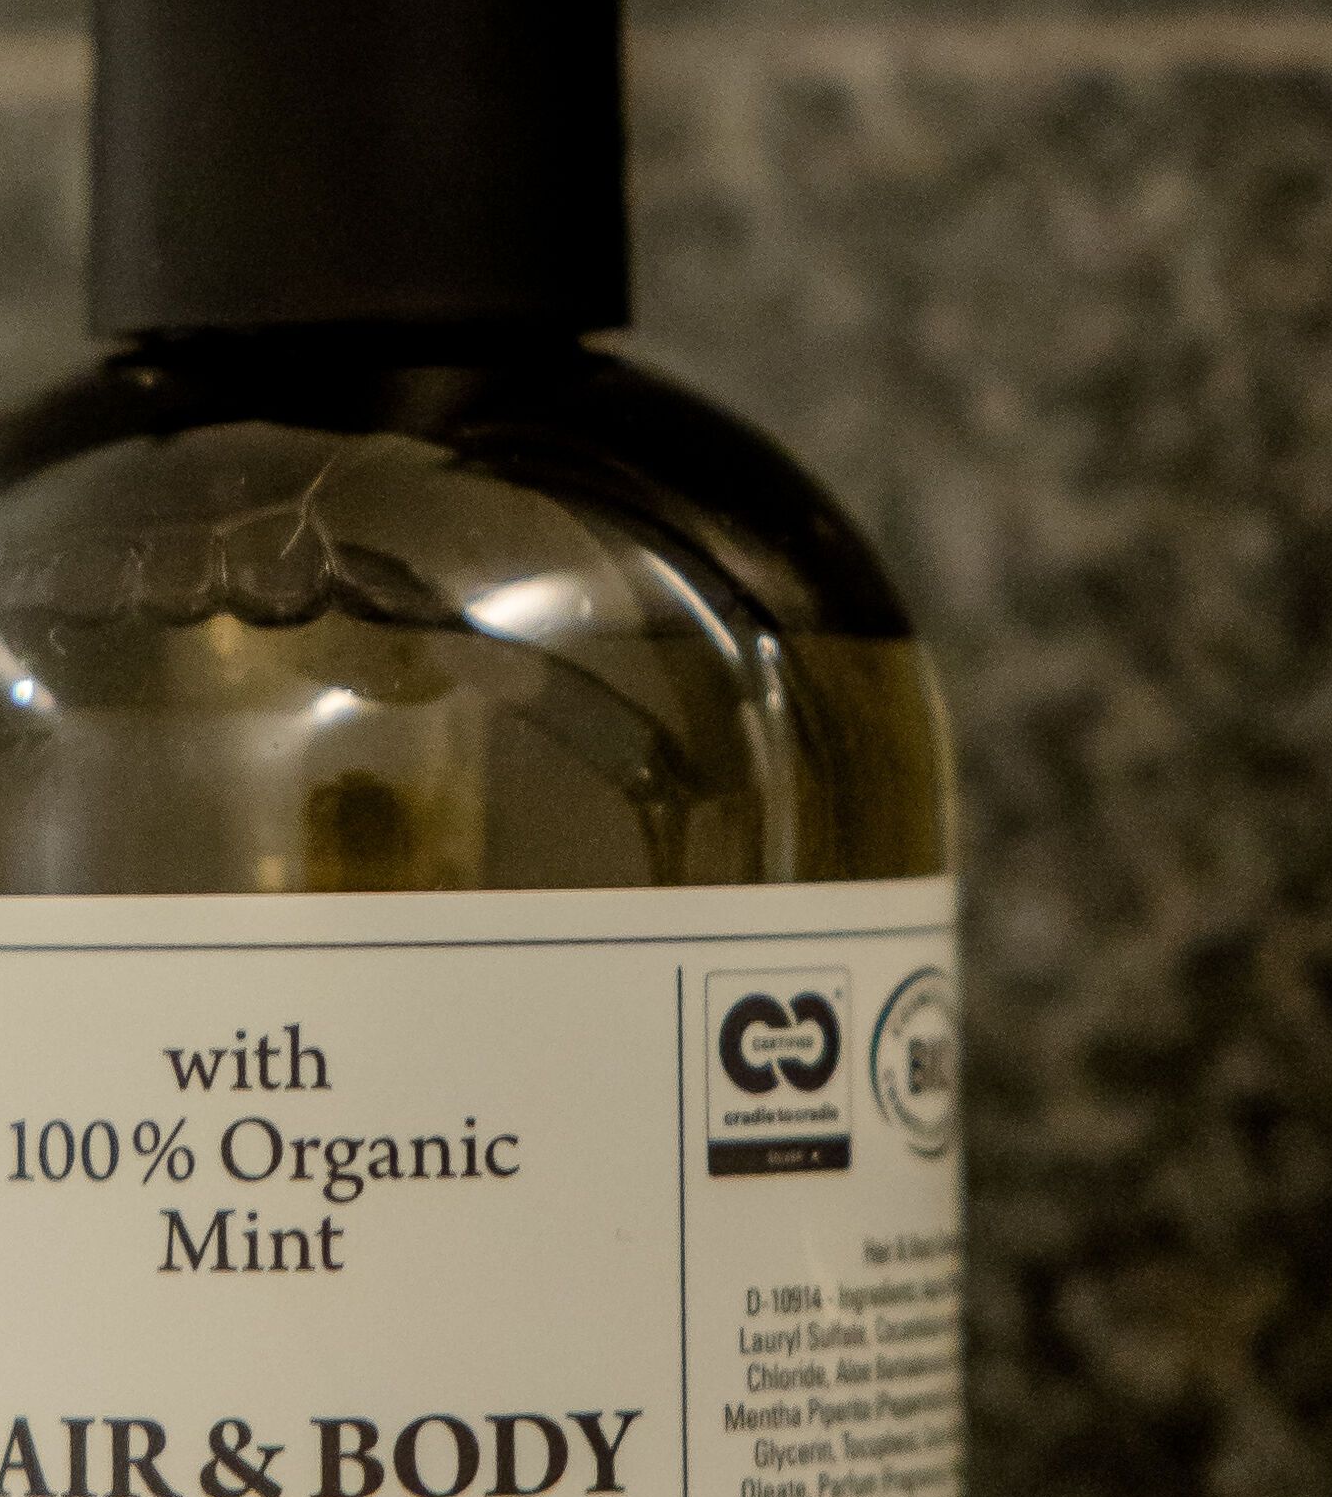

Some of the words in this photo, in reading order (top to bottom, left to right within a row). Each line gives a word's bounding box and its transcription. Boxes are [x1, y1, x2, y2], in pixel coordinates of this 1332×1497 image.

[164, 1022, 332, 1092] with
[8, 1117, 196, 1185] 100%
[220, 1117, 521, 1204] Organic
[158, 1209, 347, 1274] Mint
[737, 1325, 803, 1357] Lauryl
[724, 1400, 803, 1432] Mentha
